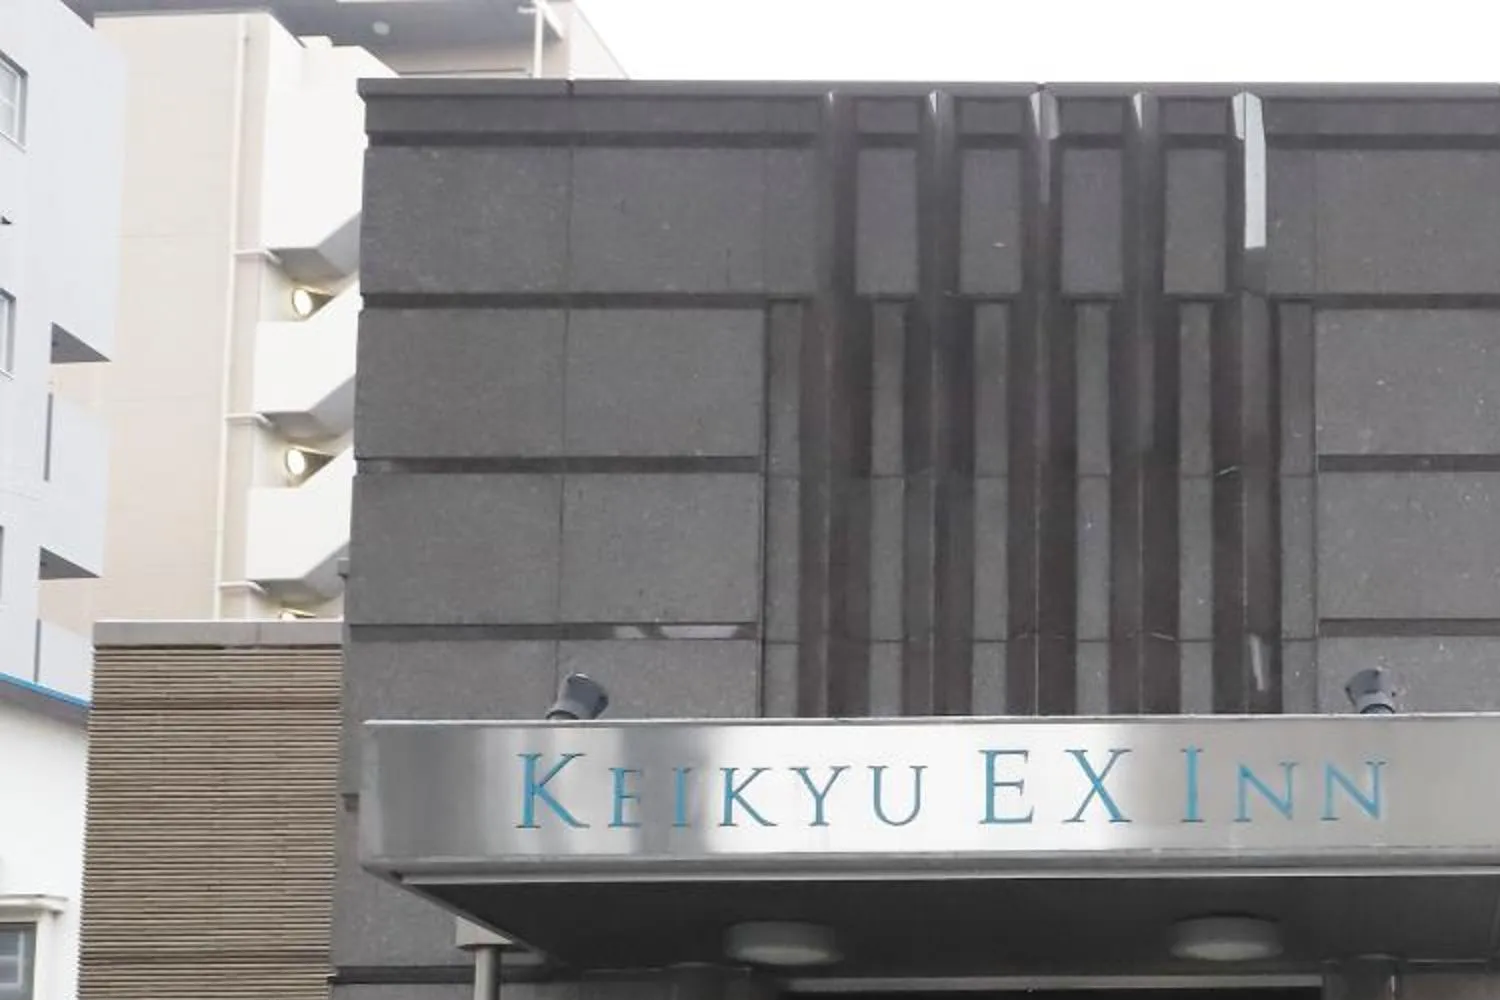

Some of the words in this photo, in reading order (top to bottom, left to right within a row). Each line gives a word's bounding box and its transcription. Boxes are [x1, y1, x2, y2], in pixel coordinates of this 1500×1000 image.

[515, 752, 928, 829] KEIKYU
[977, 748, 1133, 825] EX
[1180, 745, 1386, 824] INN
